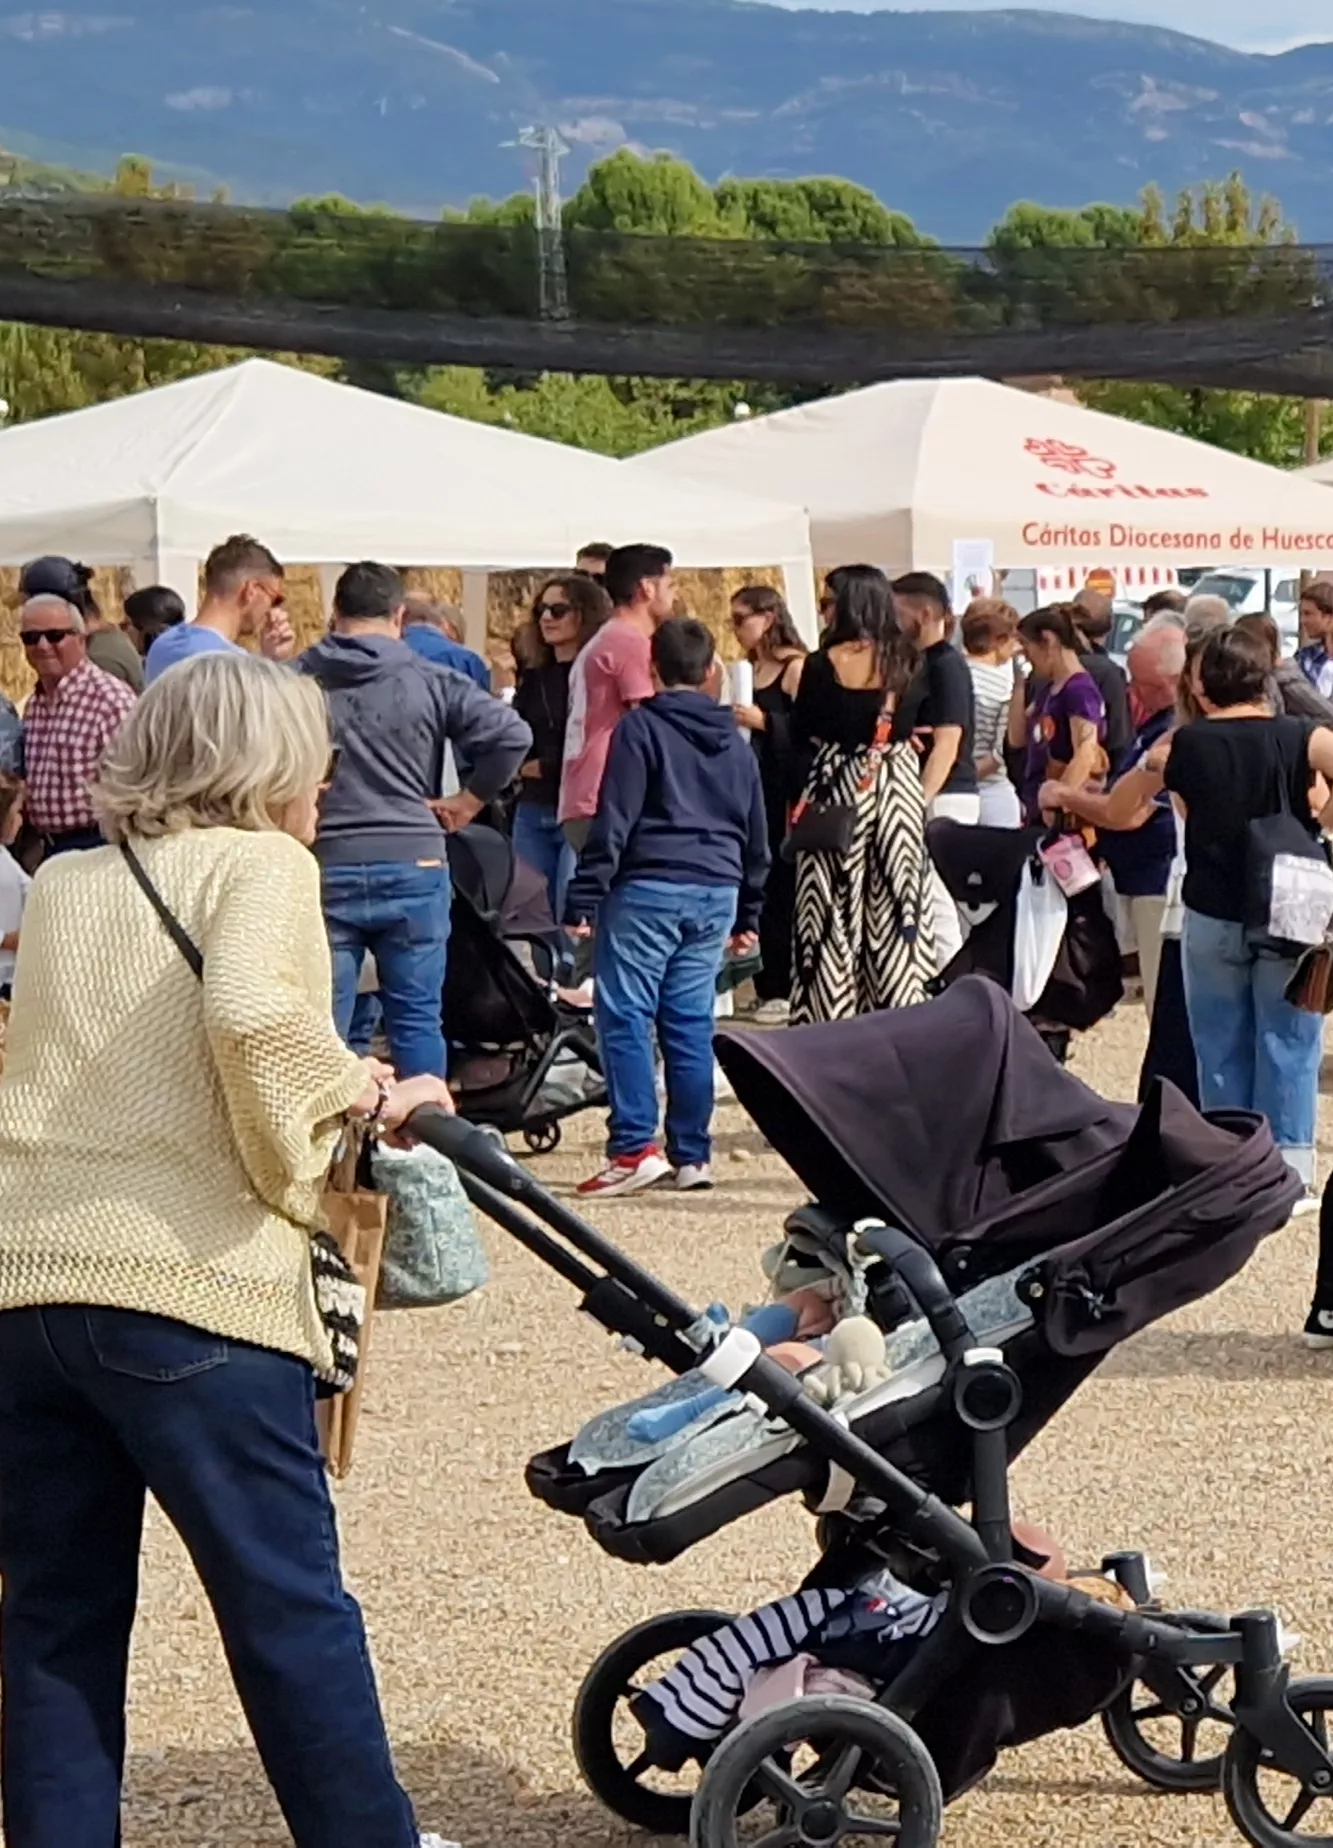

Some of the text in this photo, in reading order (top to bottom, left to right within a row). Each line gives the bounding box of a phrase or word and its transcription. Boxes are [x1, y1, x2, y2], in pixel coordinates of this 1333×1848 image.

[1021, 520, 1101, 547] Cáritas
[1109, 523, 1222, 549] Diocesana
[1229, 526, 1255, 550] de
